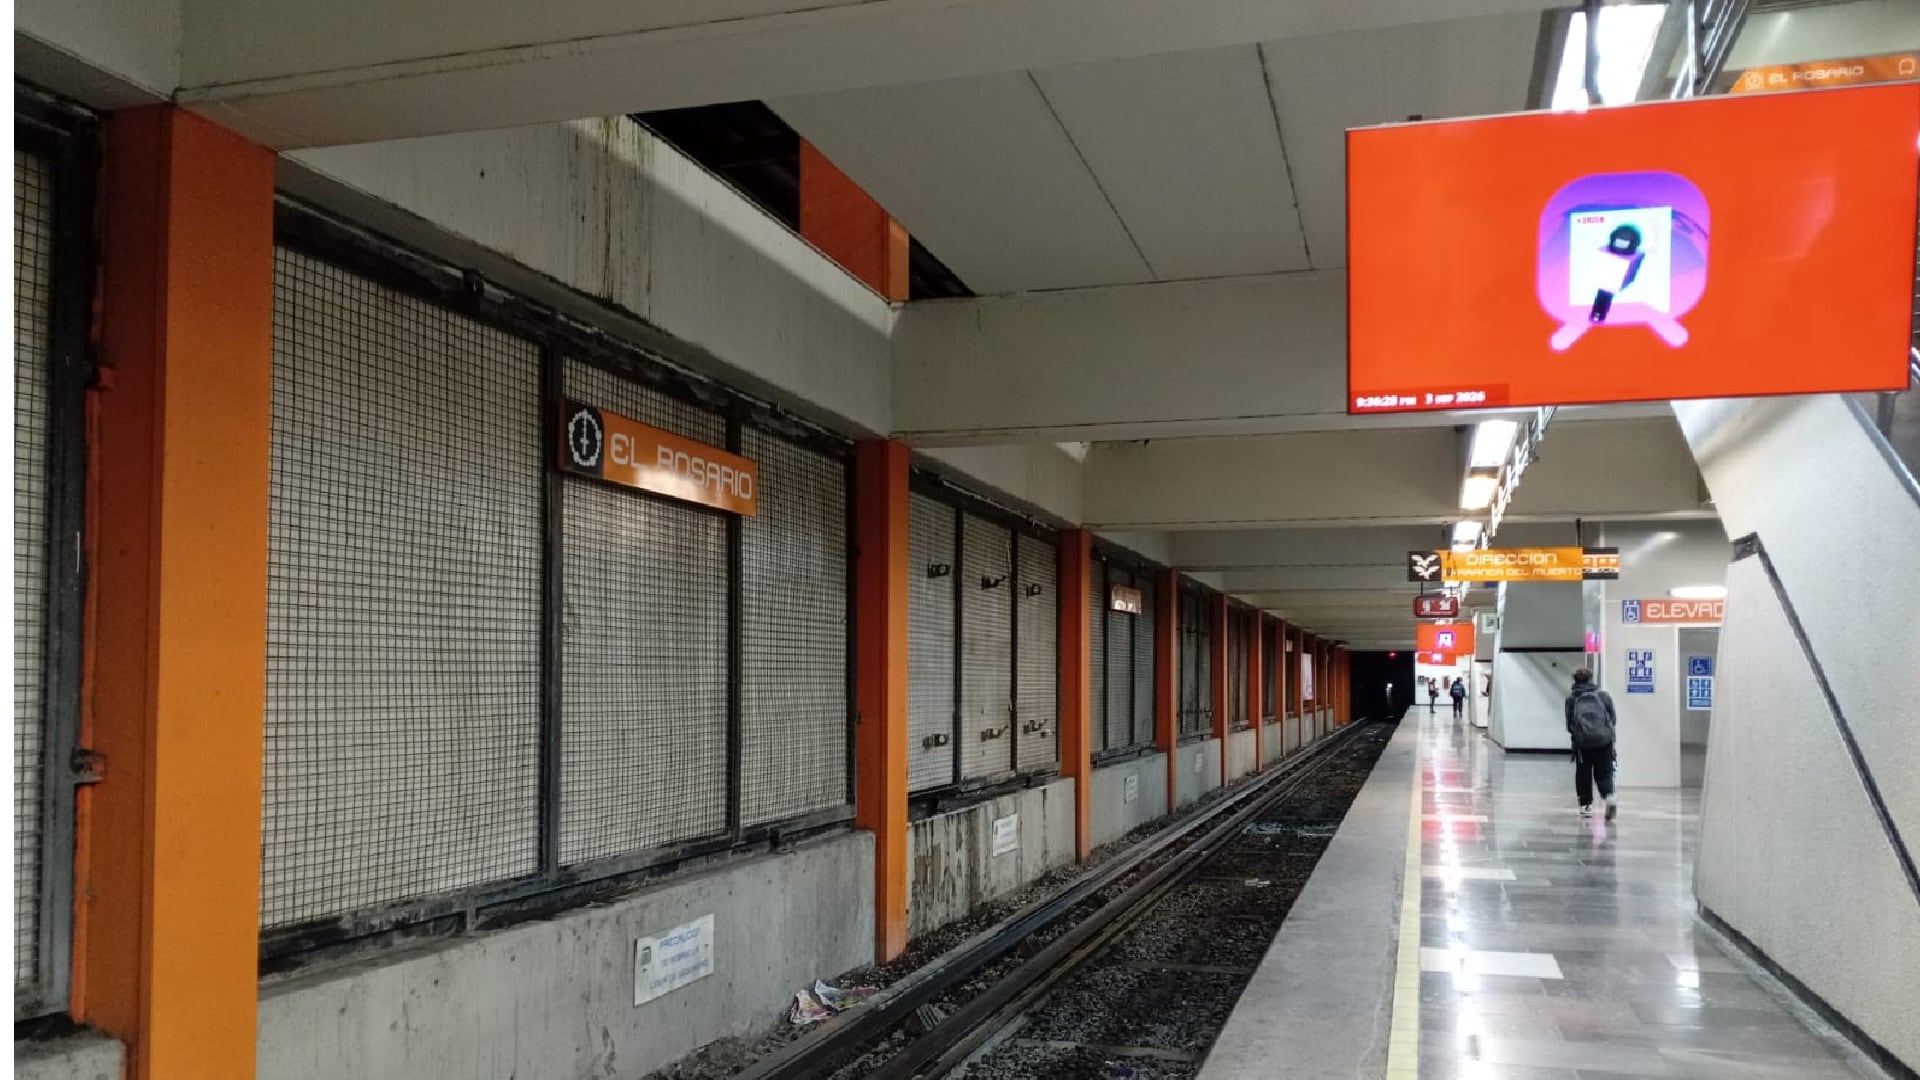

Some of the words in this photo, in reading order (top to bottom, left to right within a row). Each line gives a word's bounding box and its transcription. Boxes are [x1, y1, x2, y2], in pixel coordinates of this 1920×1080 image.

[1768, 72, 1788, 84] EL
[1792, 65, 1864, 81] ROSARIO
[611, 432, 642, 469] EL
[656, 445, 752, 500] ROSARIO
